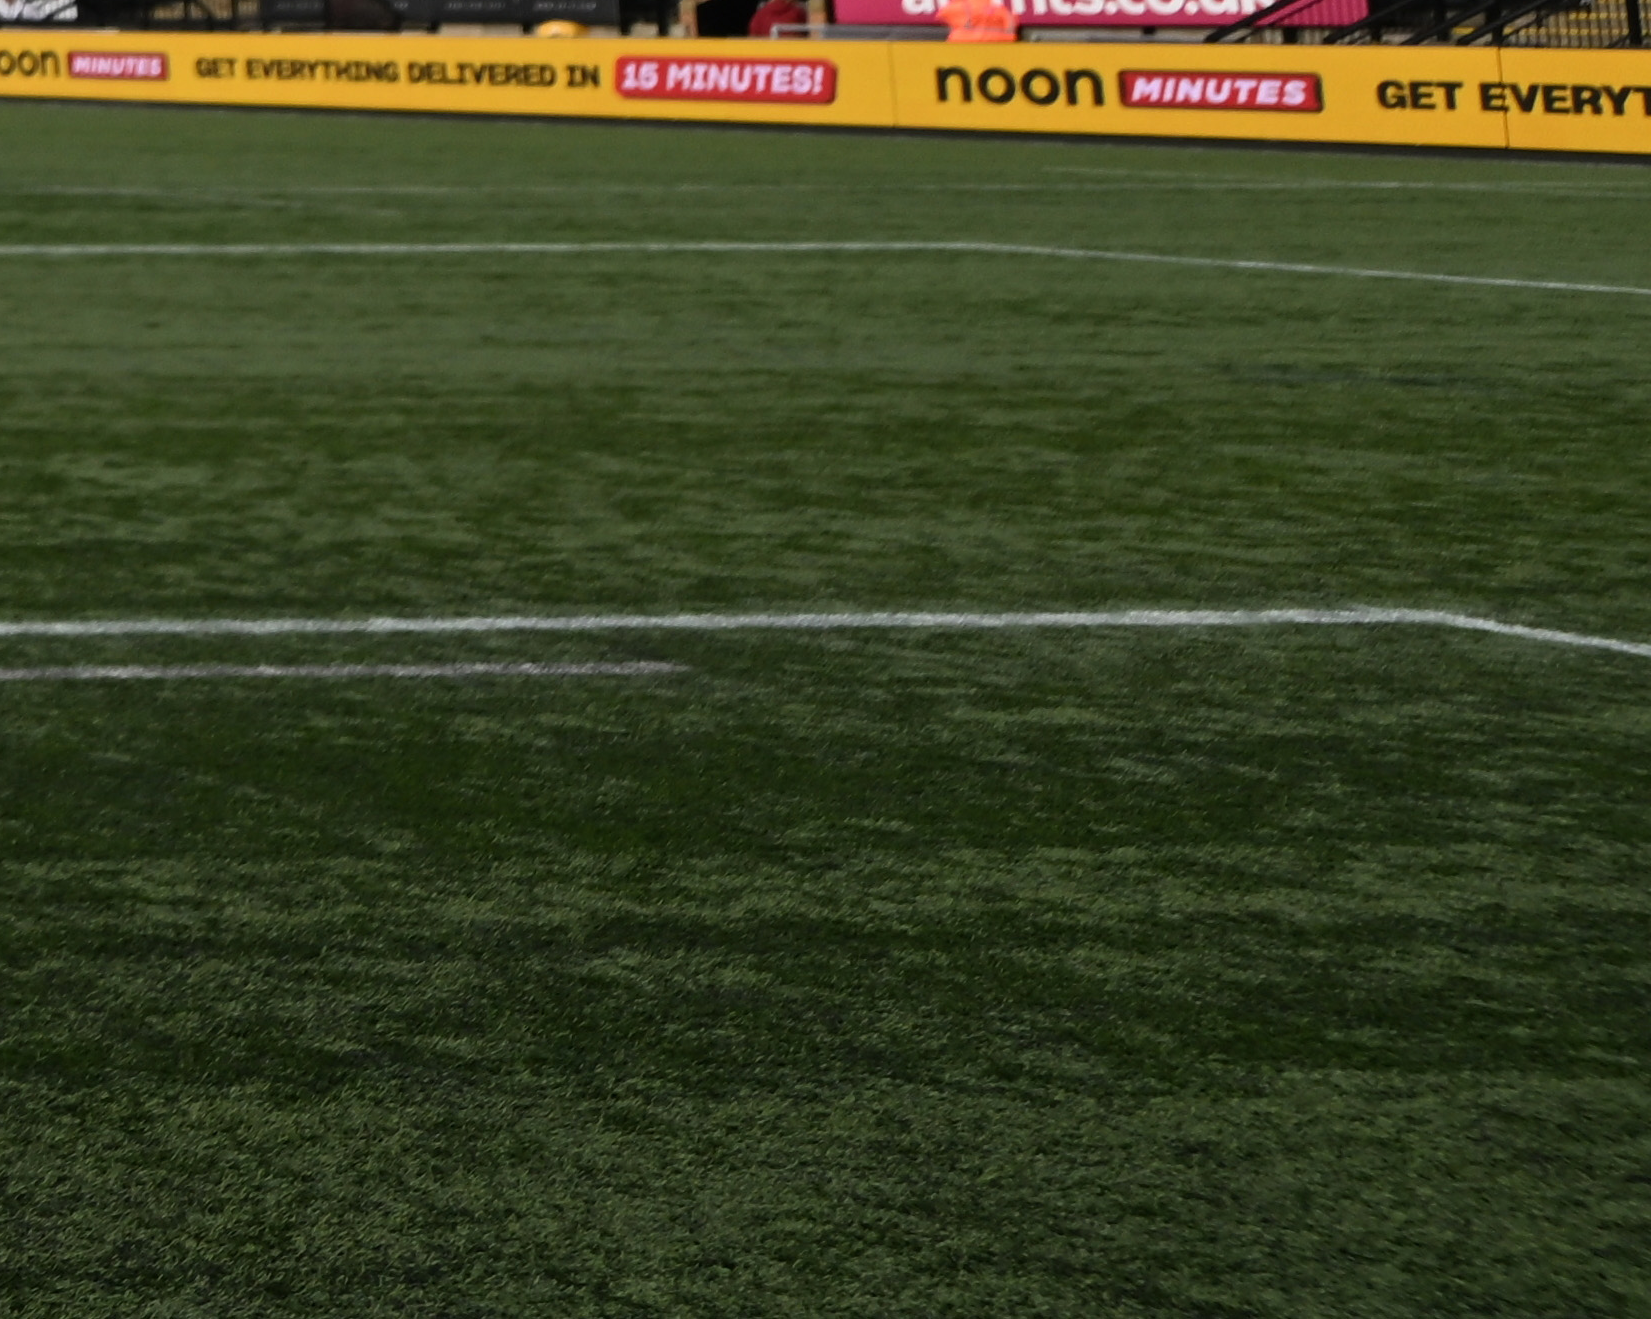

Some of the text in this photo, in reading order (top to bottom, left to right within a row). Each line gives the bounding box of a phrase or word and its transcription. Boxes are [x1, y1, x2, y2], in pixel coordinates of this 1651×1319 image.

[72, 54, 163, 77] MINUTES
[195, 57, 601, 89] GET EVERYTHING DELIVERED IN
[621, 61, 824, 96] 15 MINUTES!
[936, 66, 1307, 107] noon MINUTES
[1376, 79, 1464, 111] GET
